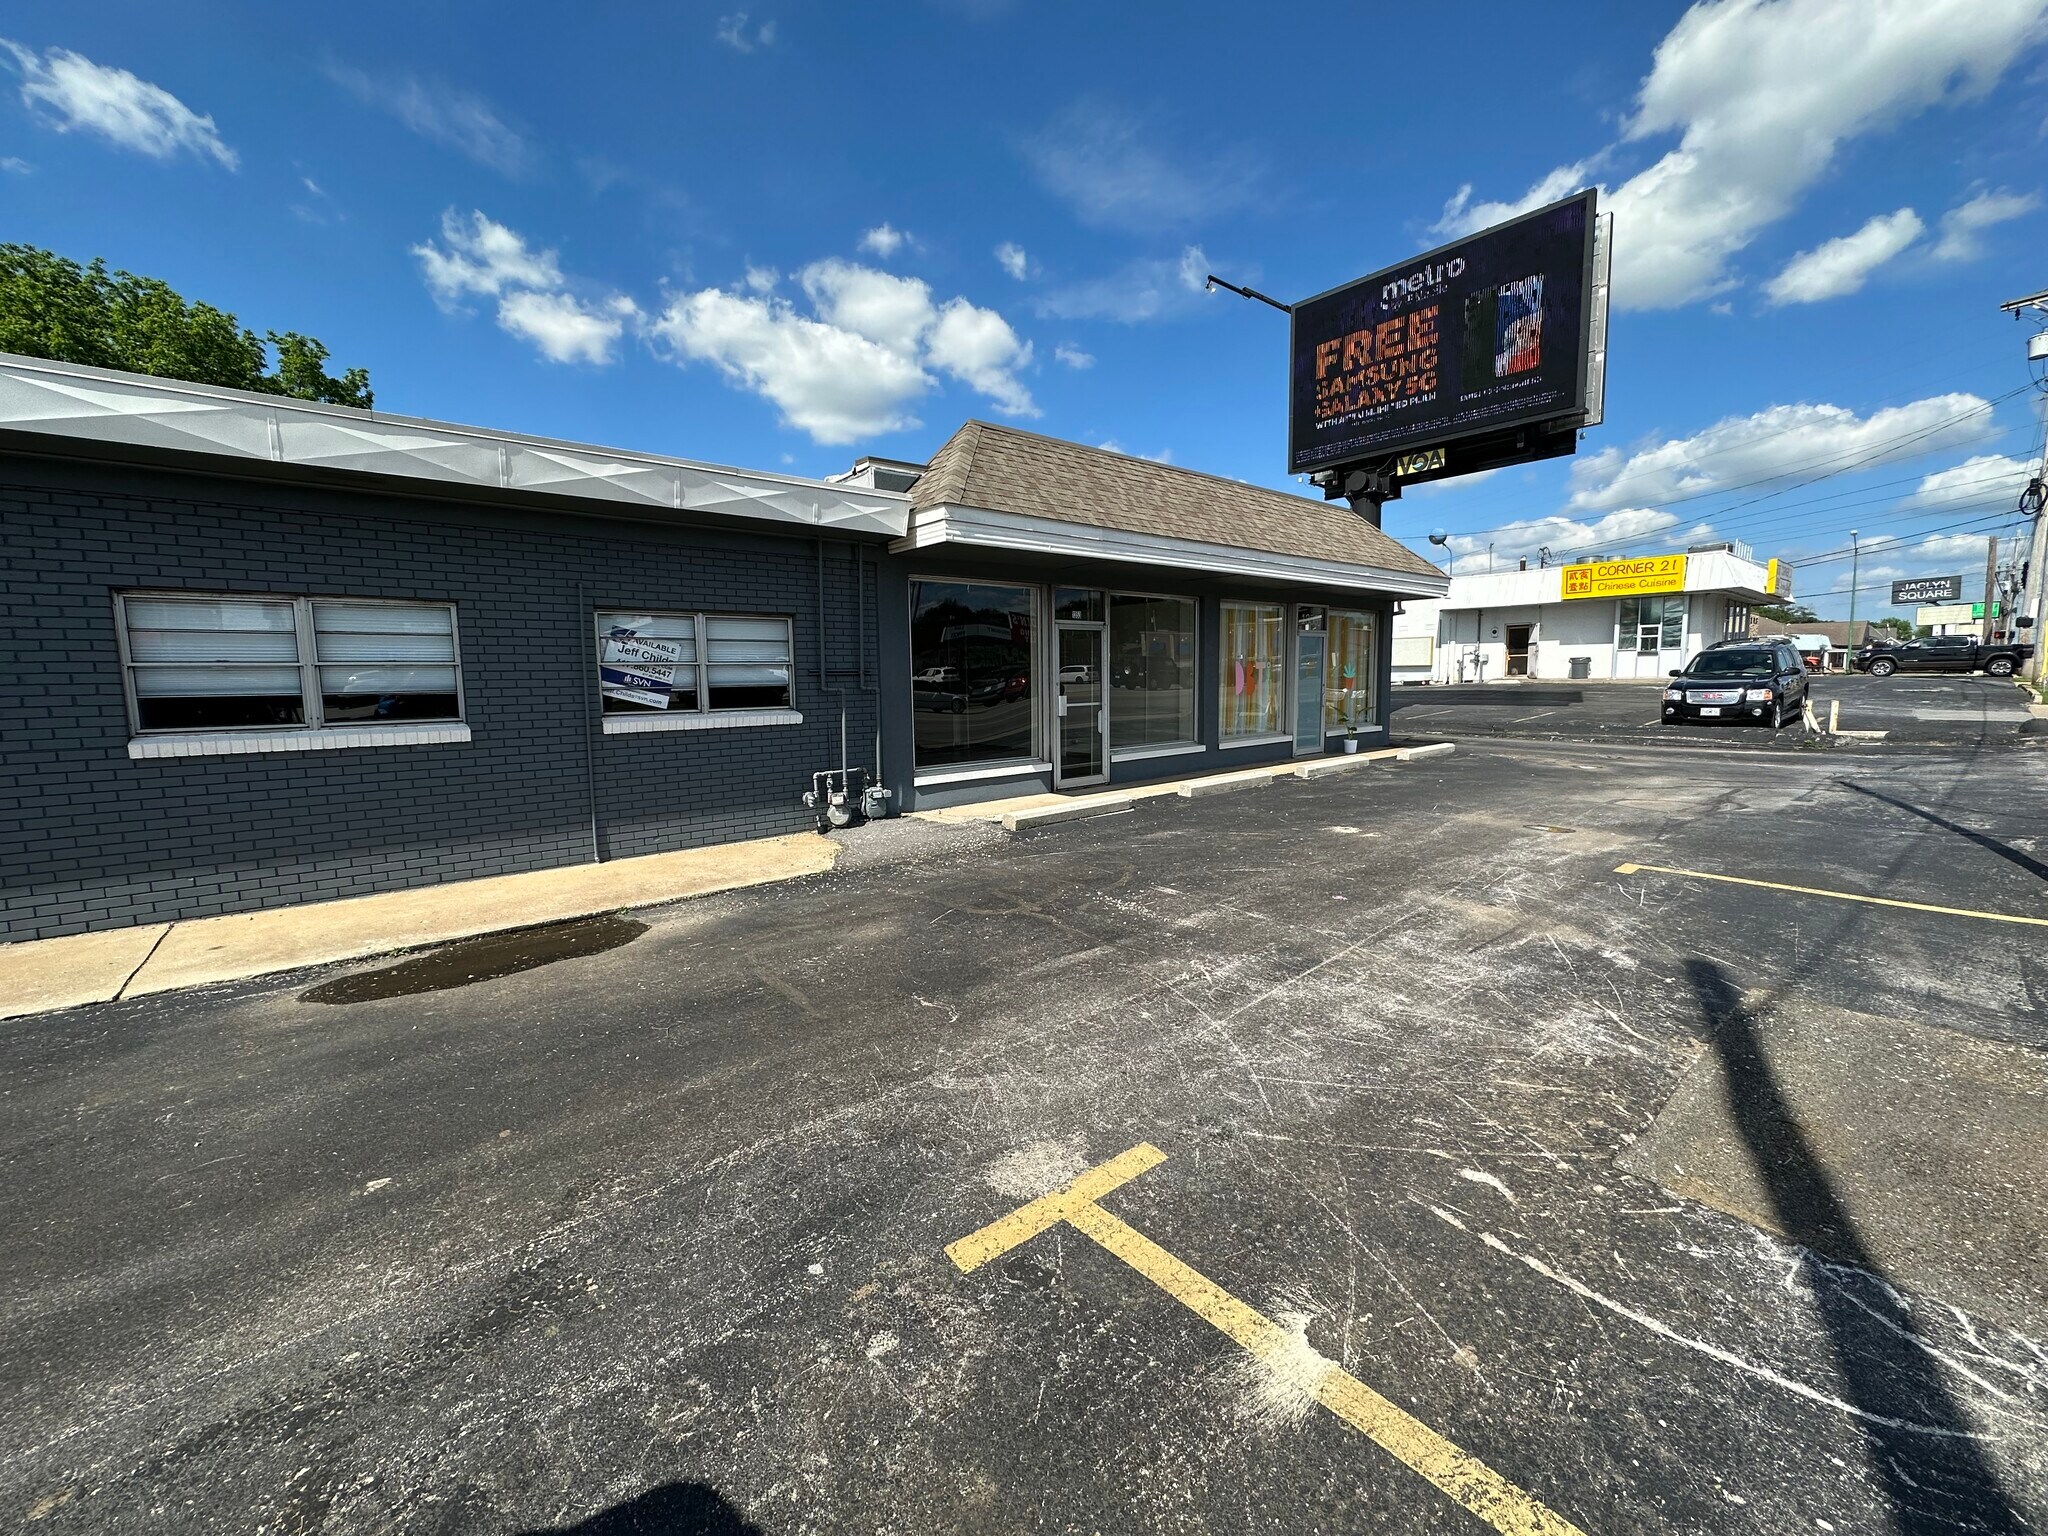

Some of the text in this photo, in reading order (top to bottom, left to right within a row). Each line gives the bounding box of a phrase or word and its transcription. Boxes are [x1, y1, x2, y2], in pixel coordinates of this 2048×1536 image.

[1381, 257, 1465, 302] metro
[1316, 305, 1439, 380] FREE
[1316, 348, 1438, 400] SAMSUNG
[1315, 380, 1402, 418] GALAXY
[1405, 371, 1437, 395] 5G
[1399, 450, 1444, 474] VOA
[1598, 560, 1677, 577] CORNER 21
[1598, 578, 1677, 591] Chinese Cuisine
[1901, 580, 1950, 591] JACLYN
[1898, 589, 1952, 600] SQUARE
[618, 645, 639, 657] Jeff
[634, 639, 677, 654] AVAILABLE
[616, 659, 672, 678] .860.5447
[632, 677, 652, 687] SVN
